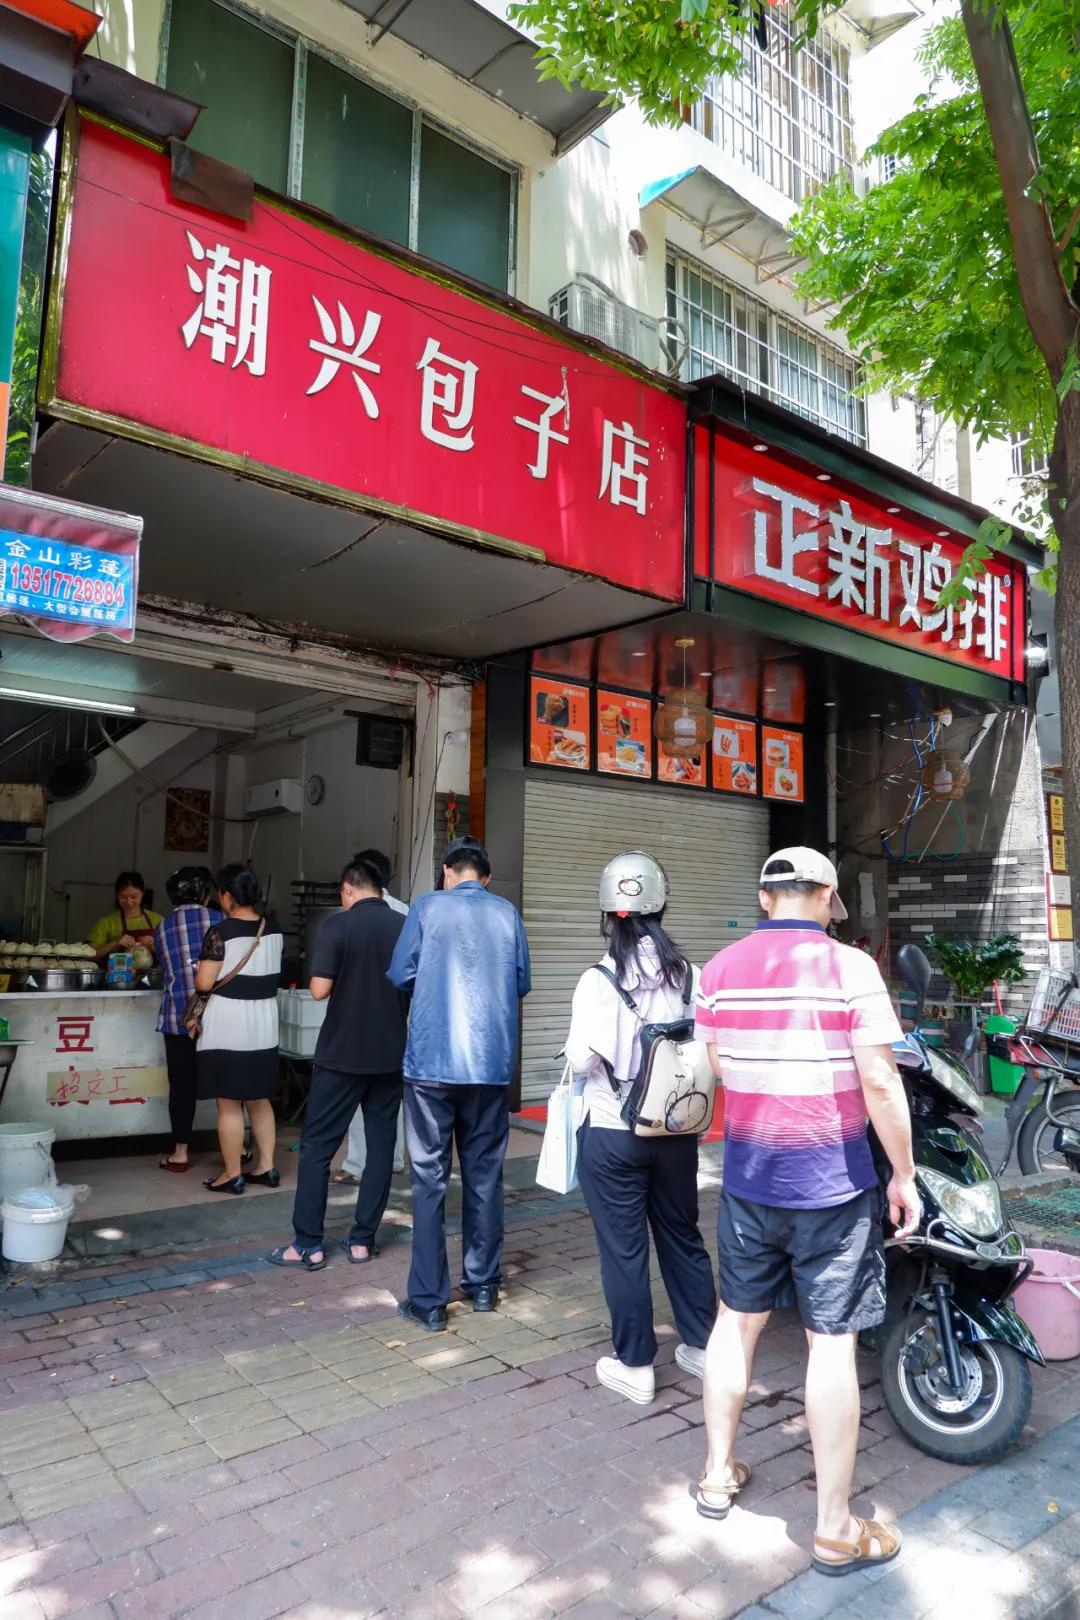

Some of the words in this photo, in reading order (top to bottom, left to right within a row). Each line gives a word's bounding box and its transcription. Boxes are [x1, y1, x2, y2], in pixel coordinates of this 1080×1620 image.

[181, 230, 651, 516] 潮兴包子店
[11, 562, 125, 607] 13517726884
[752, 476, 1007, 662] 正新鸡排
[54, 1016, 95, 1053] 豆
